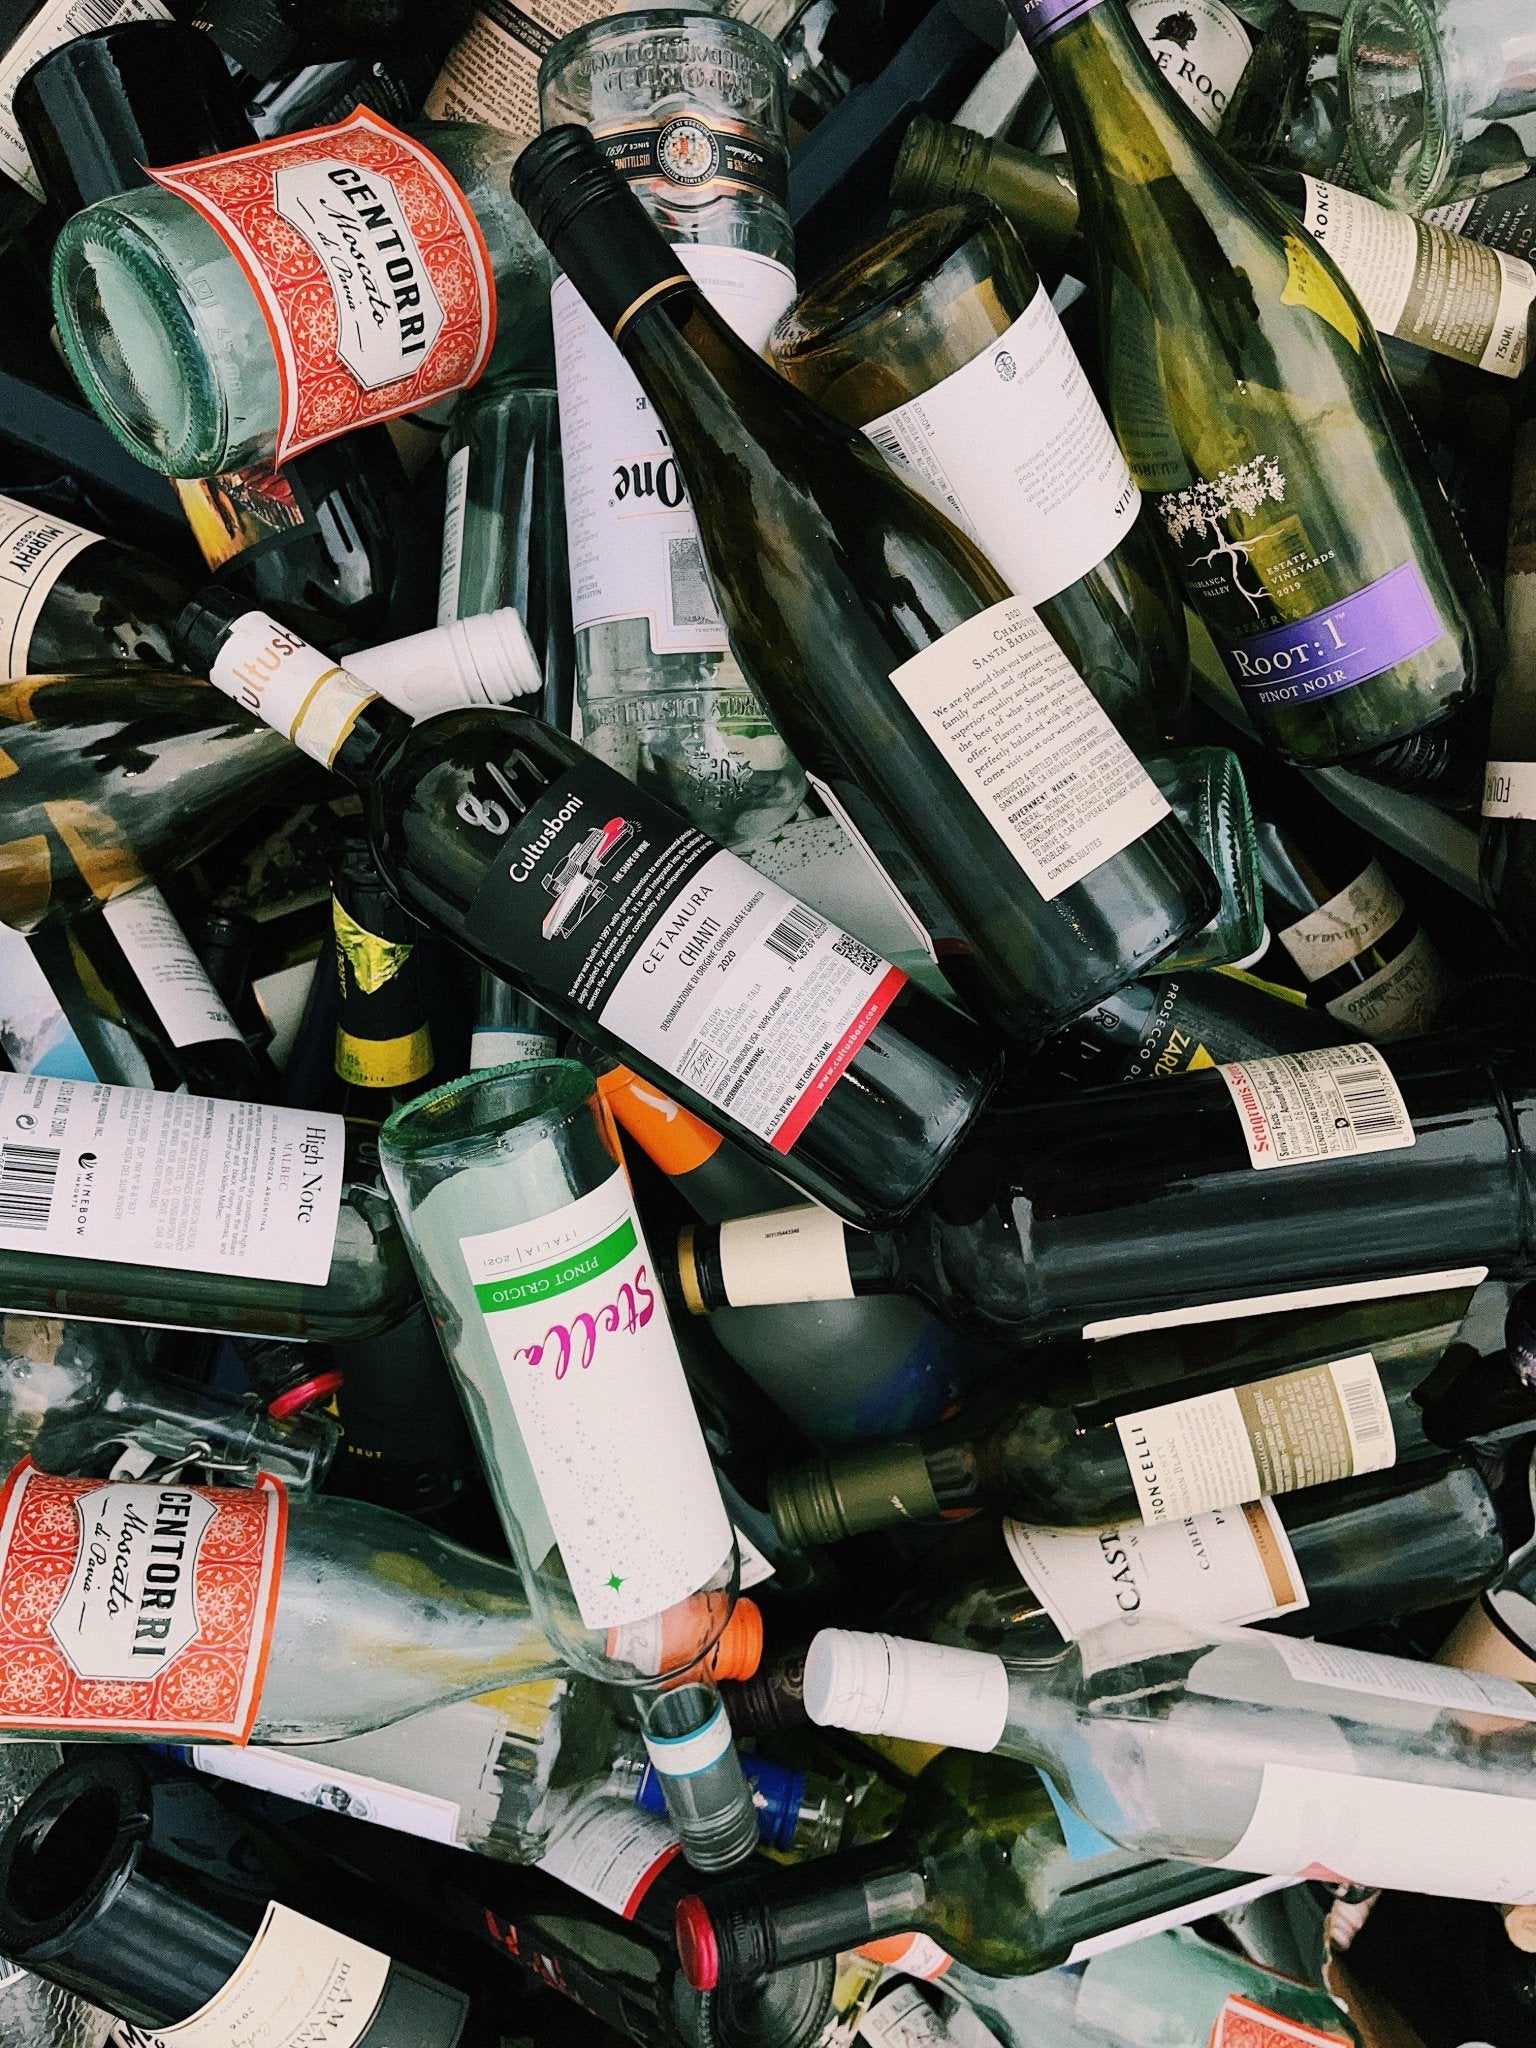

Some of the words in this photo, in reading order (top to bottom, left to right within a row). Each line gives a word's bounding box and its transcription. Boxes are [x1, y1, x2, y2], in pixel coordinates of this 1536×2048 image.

[605, 143, 627, 155] 1691
[629, 141, 649, 149] SINCE
[316, 229, 339, 248] di
[330, 255, 362, 310] Pavia
[319, 189, 390, 327] Moscato
[1493, 322, 1516, 360] 750ML
[911, 402, 931, 430] EDITION
[926, 429, 935, 437] 3
[1013, 448, 1047, 475] Delicious
[9, 524, 64, 573] MURPHY
[1265, 552, 1309, 575] ESTATE
[1267, 550, 1335, 583] VINEYARDS
[1202, 584, 1229, 598] VALLEY
[1276, 581, 1301, 597] 2019
[971, 645, 1007, 670] SANTA
[932, 705, 948, 717] We
[948, 695, 963, 709] are
[962, 673, 992, 701] pleased
[991, 665, 1008, 679] that
[1006, 657, 1021, 671] you
[1018, 649, 1034, 662] have
[1258, 684, 1298, 704] PINOT
[1302, 666, 1348, 693] NOIR
[950, 713, 985, 741] superior
[987, 694, 1014, 716] quality
[1013, 682, 1029, 697] and
[1027, 673, 1046, 687] value.
[973, 747, 1010, 778] perfectly
[1009, 721, 1045, 749] balanced
[1045, 711, 1061, 725] with
[982, 767, 1005, 786] come
[1004, 754, 1023, 769] visit
[1022, 747, 1034, 757] us
[1033, 741, 1042, 750] at
[1041, 732, 1055, 745] our
[1054, 719, 1077, 736] winery
[1007, 791, 1047, 823] GOVERNMENT
[1051, 771, 1077, 793] WARNING:
[509, 793, 582, 881] Cultusboni
[635, 838, 651, 855] WINE
[619, 854, 637, 875] SHAPE
[631, 849, 641, 859] OF
[646, 864, 657, 874] to
[1047, 855, 1077, 880] CONTAINS
[1074, 837, 1102, 860] SULFITES
[611, 869, 625, 884] THE
[629, 872, 651, 897] attention
[583, 965, 601, 989] inspired
[595, 957, 605, 967] by
[615, 915, 634, 936] castles.
[639, 886, 653, 902] well
[648, 861, 673, 889] integrated
[669, 852, 681, 865] into
[607, 910, 622, 927] with
[617, 894, 634, 914] great
[598, 924, 613, 942] 1997
[642, 886, 712, 973] CETAMURA
[678, 916, 720, 966] CHIANTI
[585, 946, 599, 962] built
[717, 949, 736, 972] 2020
[796, 935, 815, 960] 48789
[572, 971, 586, 989] winery
[581, 961, 591, 973] was
[659, 982, 694, 1031] DENOMINAZIONE
[689, 973, 700, 984] DI
[695, 949, 717, 976] ORIGINE
[713, 914, 745, 951] CONTROLLATA
[728, 1042, 754, 1075] COLTIBUONO,
[747, 1031, 761, 1045] USA
[757, 1014, 772, 1031] NAPA
[767, 984, 792, 1017] CALIFORNIA
[1137, 980, 1182, 1062] PROSECCO
[816, 1004, 877, 1089] www.cultusboni.com
[722, 1074, 745, 1107] GOVERNMENT
[741, 1046, 765, 1076] WARNING:
[769, 1112, 783, 1127] 12.5%
[778, 1104, 788, 1114] BY
[783, 1093, 796, 1106] VOL.
[794, 1077, 806, 1090] NET
[802, 1061, 818, 1079] CONT.
[813, 1049, 826, 1063] 750
[821, 1041, 832, 1051] ML
[1301, 1086, 1316, 1111] BOTTLED
[1386, 1098, 1405, 1126] 87000
[48, 1116, 67, 1139] 750ML
[1309, 1110, 1320, 1124] AND
[299, 1126, 326, 1165] High
[1274, 1131, 1289, 1157] Serving
[1314, 1123, 1328, 1154] BLENDED
[266, 1146, 275, 1181] MENDOZA,
[278, 1142, 293, 1189] MALBEC
[70, 1173, 81, 1208] IMPORTS
[76, 1171, 94, 1235] WINEBOW
[297, 1172, 322, 1223] Note
[259, 1186, 271, 1231] ARGENTINA
[524, 1229, 577, 1256] ITALIA
[482, 1254, 510, 1267] 2021
[555, 1256, 598, 1285] PINOT
[492, 1278, 549, 1302] GRIGIO
[497, 1263, 669, 1391] Stella
[347, 1444, 382, 1458] BRUT
[93, 1522, 111, 1538] di
[82, 1542, 107, 1591] Pavia
[107, 1503, 147, 1621] Moscato
[133, 1492, 191, 1655] CENTORRI
[317, 1961, 351, 2014] DELLA
[229, 2005, 254, 2032] 2016
